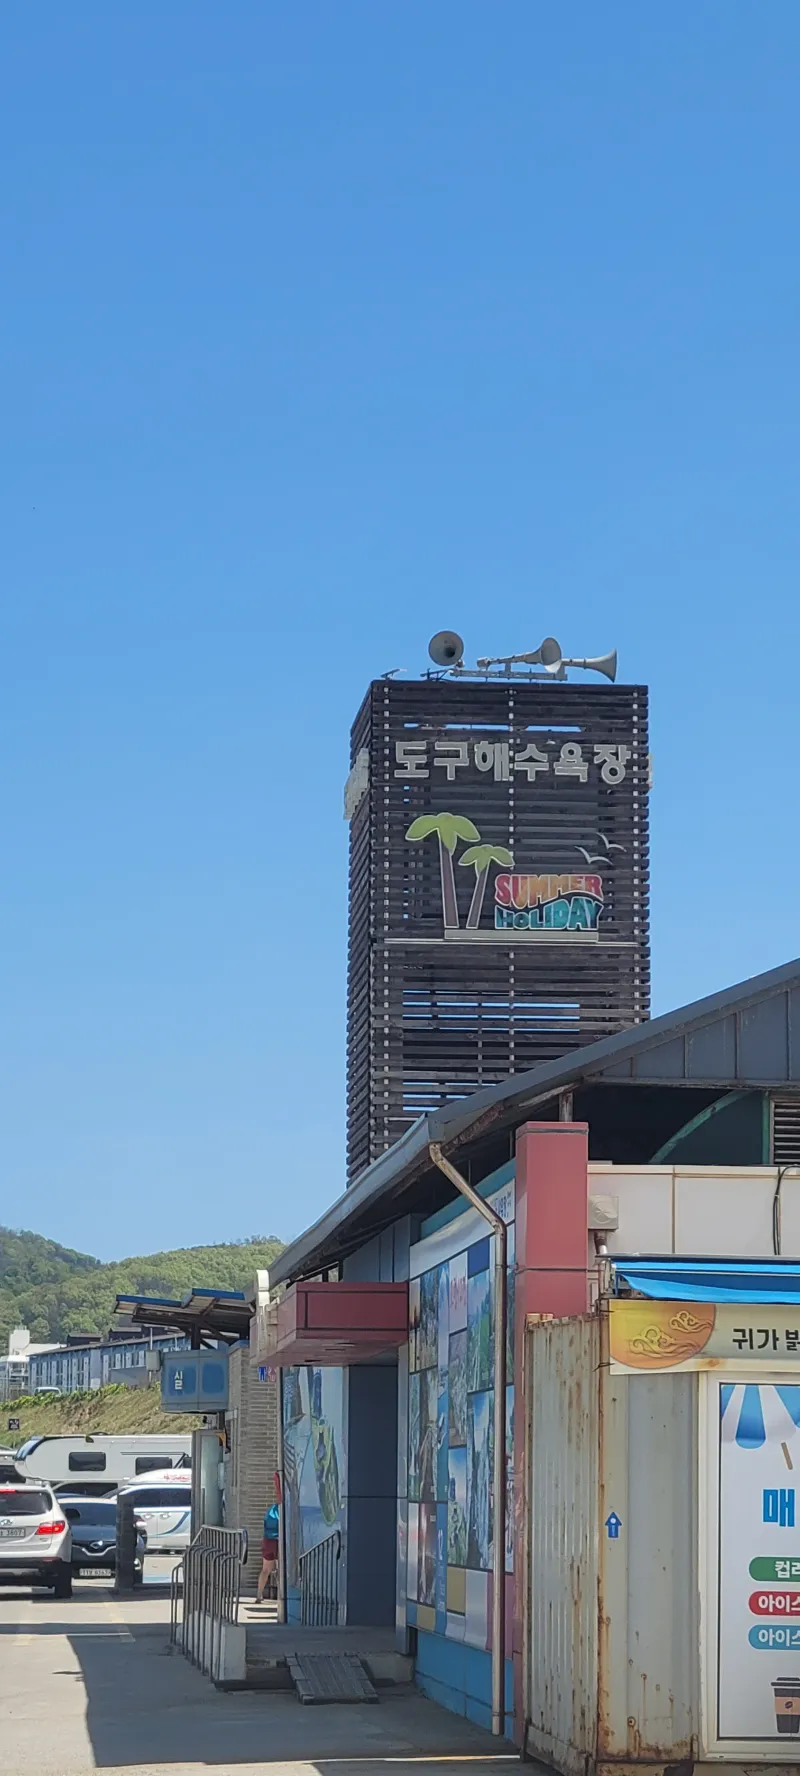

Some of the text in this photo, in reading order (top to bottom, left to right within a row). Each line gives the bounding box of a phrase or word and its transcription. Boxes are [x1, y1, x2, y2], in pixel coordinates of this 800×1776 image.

[394, 740, 632, 784] 도구해수욕장
[495, 873, 604, 910] SUMMER
[495, 896, 604, 931] HOLIDAY
[732, 1327, 780, 1351] 귀가
[762, 1488, 795, 1528] 매
